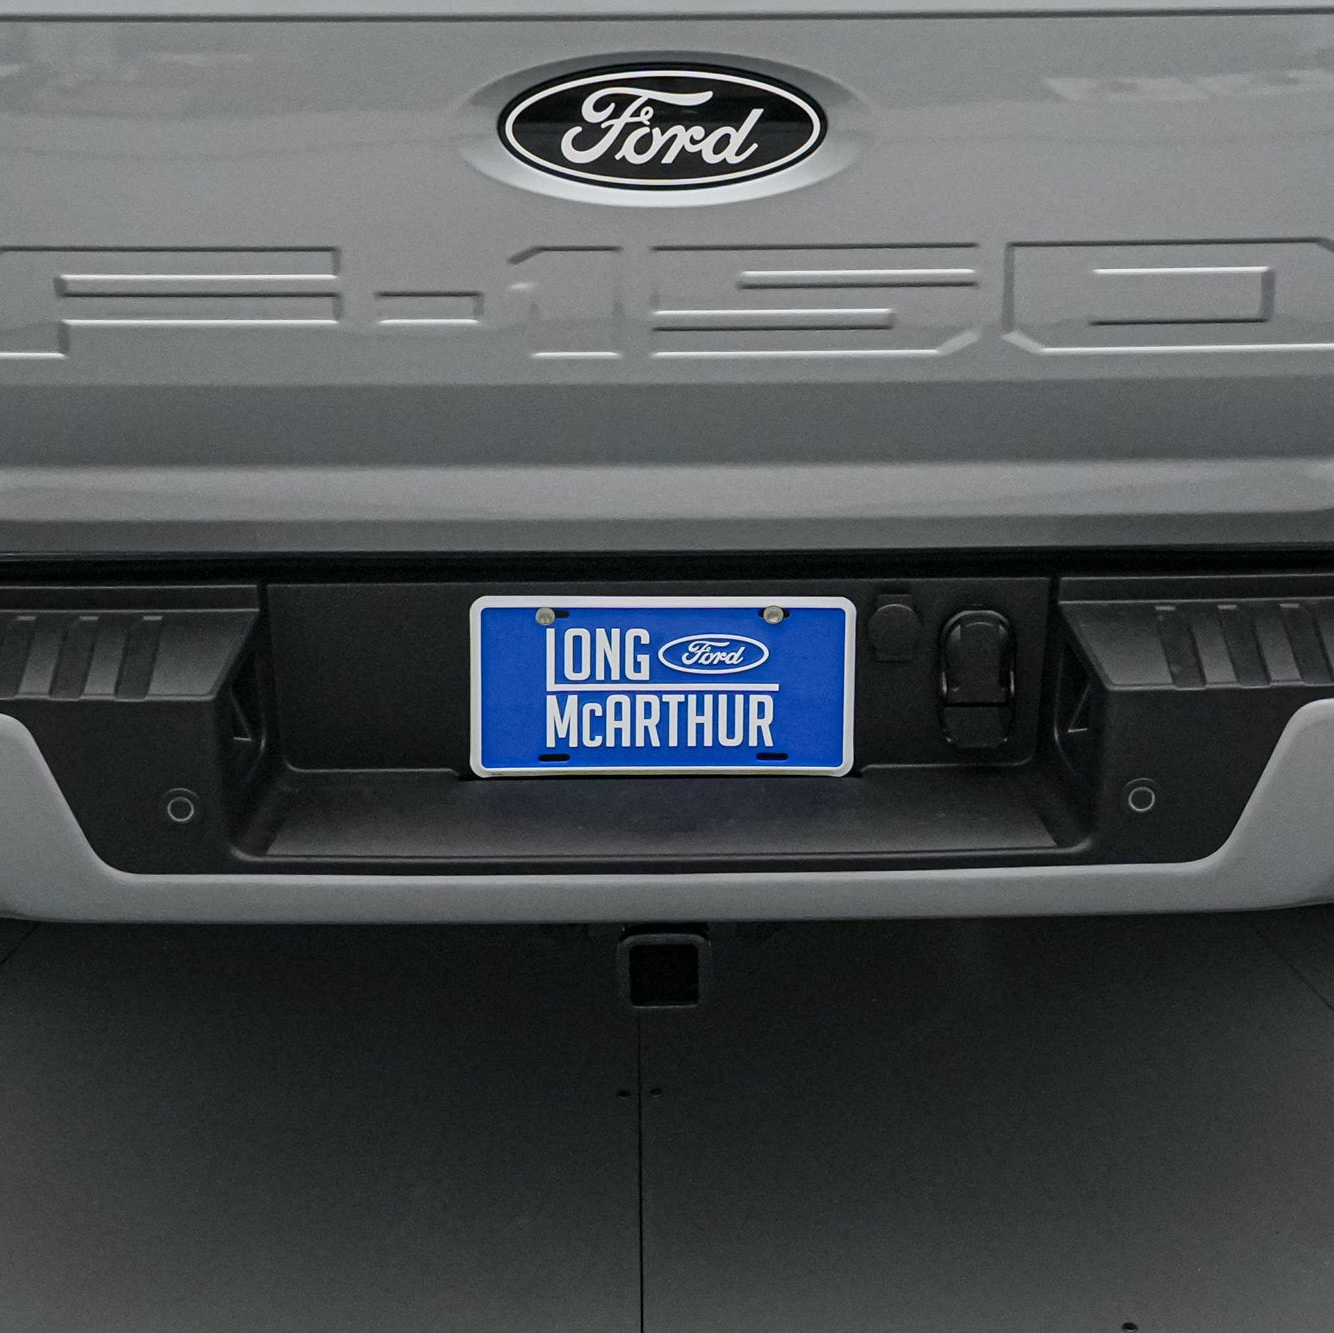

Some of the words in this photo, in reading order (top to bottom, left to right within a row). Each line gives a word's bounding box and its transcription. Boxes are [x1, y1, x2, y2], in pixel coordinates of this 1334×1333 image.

[560, 85, 761, 166] Ford
[546, 627, 650, 691] LONG
[681, 640, 745, 666] Ford
[546, 694, 774, 748] McARTHUR
